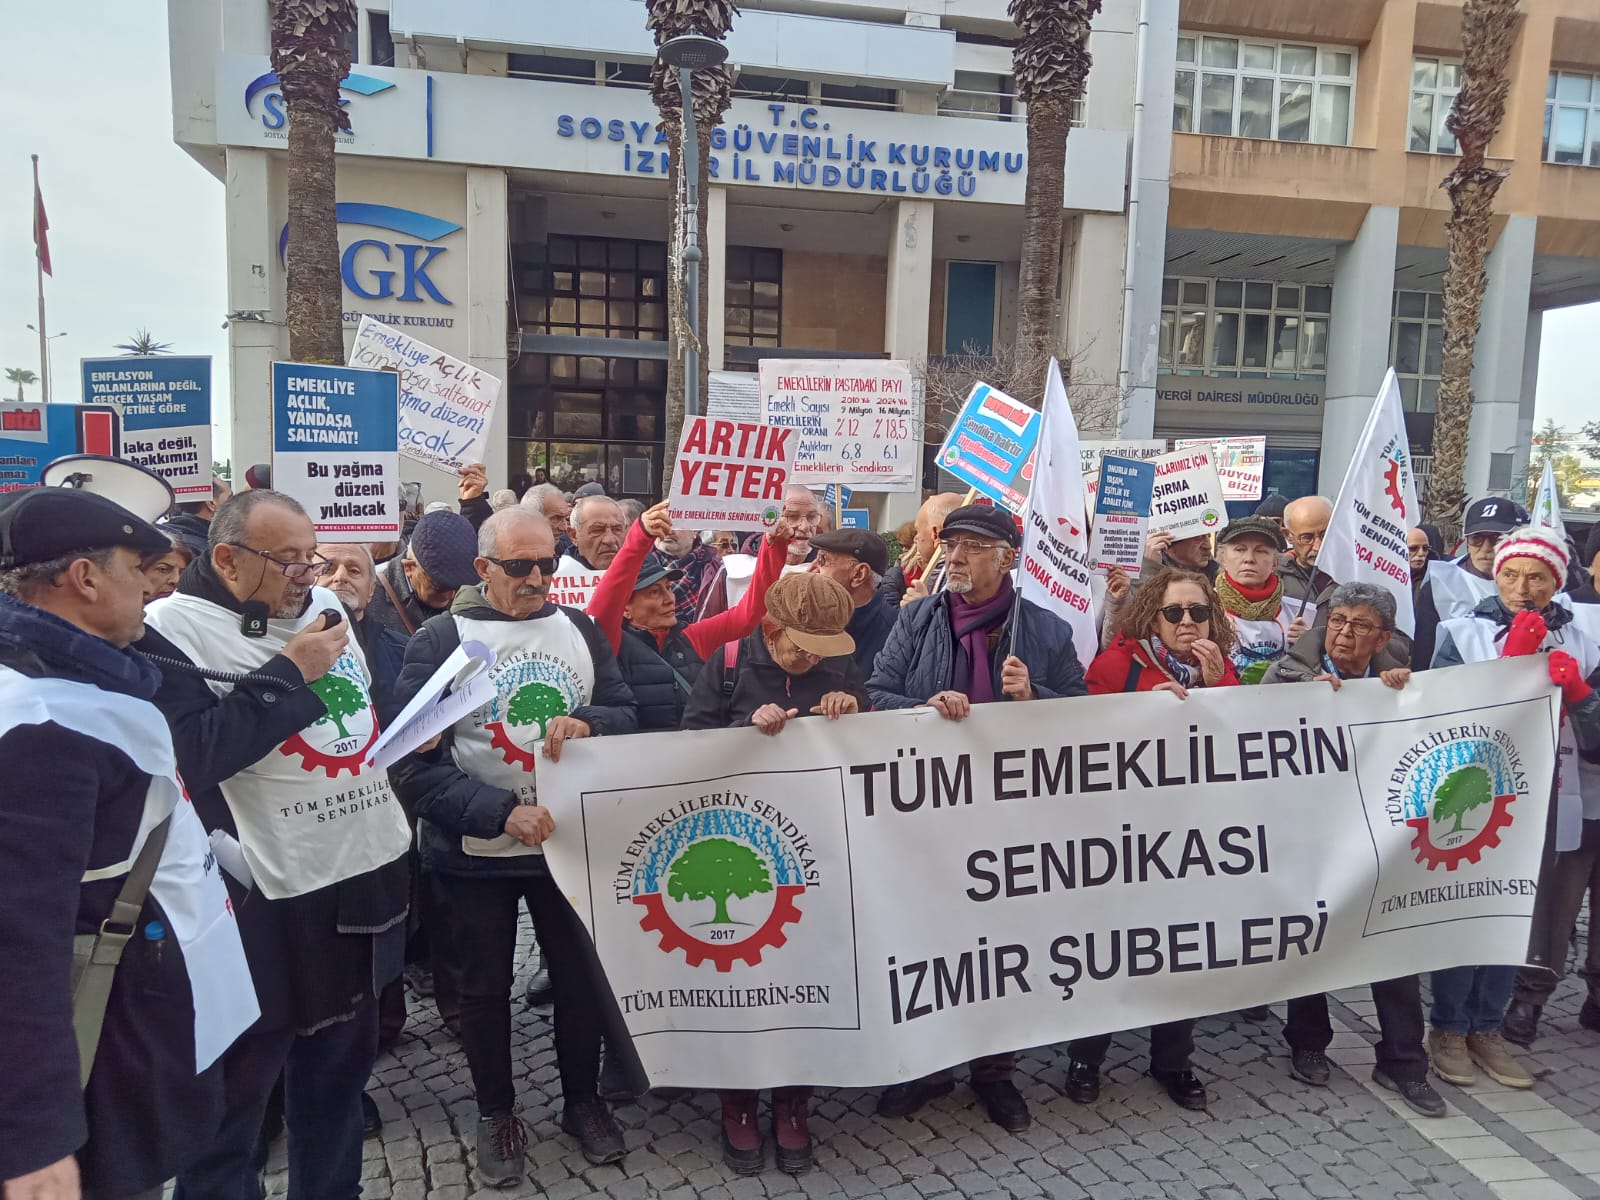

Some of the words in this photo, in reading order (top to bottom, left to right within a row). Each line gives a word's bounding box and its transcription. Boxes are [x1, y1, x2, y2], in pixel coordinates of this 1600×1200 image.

[768, 104, 830, 130] T.C.
[557, 114, 668, 144] SOSYA
[711, 124, 877, 162] GÜVENLİK
[888, 142, 1023, 173] KURUMU
[624, 143, 719, 178] İZR
[733, 152, 760, 181] İL
[773, 158, 977, 196] MÜDÜRLÜĞÜ
[341, 239, 453, 305] GK
[403, 316, 455, 328] KURUMU
[360, 324, 429, 367] Emekliye
[91, 370, 153, 382] ENFLASYON
[777, 374, 831, 392] EMEKLİLERİN
[835, 376, 878, 393] PASTADAKİ
[881, 378, 902, 393] PAYI
[92, 382, 166, 393] YALANLARINA
[169, 380, 202, 392] DEĞİL,
[287, 377, 355, 395] EMEKLİYE
[92, 393, 134, 404] GERÇEK
[137, 393, 172, 406] YAŞAM
[287, 394, 330, 412] AÇLIK,
[429, 382, 492, 416] saltanat
[767, 394, 795, 412] Emekli
[801, 396, 830, 417] Sayısı
[1156, 389, 1192, 401] VERGİ
[1197, 390, 1242, 404] DAİRESİ
[1247, 391, 1319, 406] MÜDÜRLÜĞÜ
[121, 404, 156, 415] YETİNE
[158, 403, 187, 413] GÖRE
[431, 402, 485, 435] düzeni
[848, 406, 873, 416] Milyon
[887, 407, 911, 417] Milyon
[288, 411, 352, 430] YANDAŞA
[768, 414, 822, 428] EMEKLİLERİN
[287, 428, 359, 445] SALTANAT!
[682, 417, 793, 463] ARTIK
[802, 427, 828, 437] ORANI
[158, 437, 197, 452] değil,
[798, 440, 833, 452] Aylıkları
[798, 452, 815, 460] PAYI
[1155, 457, 1192, 477] KLARIMIZ
[1192, 452, 1208, 470] İÇİN
[307, 462, 329, 478] Bu
[333, 461, 383, 479] yağma
[794, 461, 844, 473] Emeklilerin
[851, 461, 894, 473] Sendikası
[1218, 468, 1261, 483] DUYUN
[335, 481, 384, 497] düzeni
[680, 459, 787, 501] YETER
[1227, 480, 1258, 493] BİZİ!
[1153, 479, 1190, 501] ŞIRMA
[320, 501, 386, 520] yıkılacak
[1155, 492, 1209, 515] TAŞIRMA!
[1353, 498, 1371, 520] TÜM
[668, 509, 683, 519] TÜM
[684, 509, 727, 521] EMEKLİLERİN
[728, 511, 760, 522] SENDİKASI
[1030, 510, 1049, 535] TÜM
[1373, 554, 1410, 588] ŞUBESİ
[547, 590, 585, 605] RİM
[1050, 580, 1091, 614] ŞUBESİ
[334, 740, 358, 754] 2017
[1390, 722, 1491, 786] EMEKLİLERİN
[850, 747, 974, 817] TÜM
[993, 718, 1349, 801] EMEKLİLERİN
[1492, 729, 1529, 796] SENDİKASI
[280, 801, 318, 818] TÜM
[1384, 787, 1402, 827] TÜM
[612, 859, 635, 905] TÜM
[626, 789, 749, 859] EMEKLİLERİN
[750, 798, 821, 889] SENDİKASI
[1446, 835, 1463, 846] 2017
[965, 823, 1269, 902] SENDİKASI
[1380, 894, 1408, 914] TÜM
[1410, 876, 1537, 908] EMEKLİLERİN-SEN
[710, 929, 735, 941] 2017
[886, 936, 1032, 1025] İZMİR
[1048, 899, 1328, 1001] ŞUBELERİ
[621, 989, 664, 1014] TÜM
[669, 981, 830, 1009] EMEKLİLERİN-SEN
